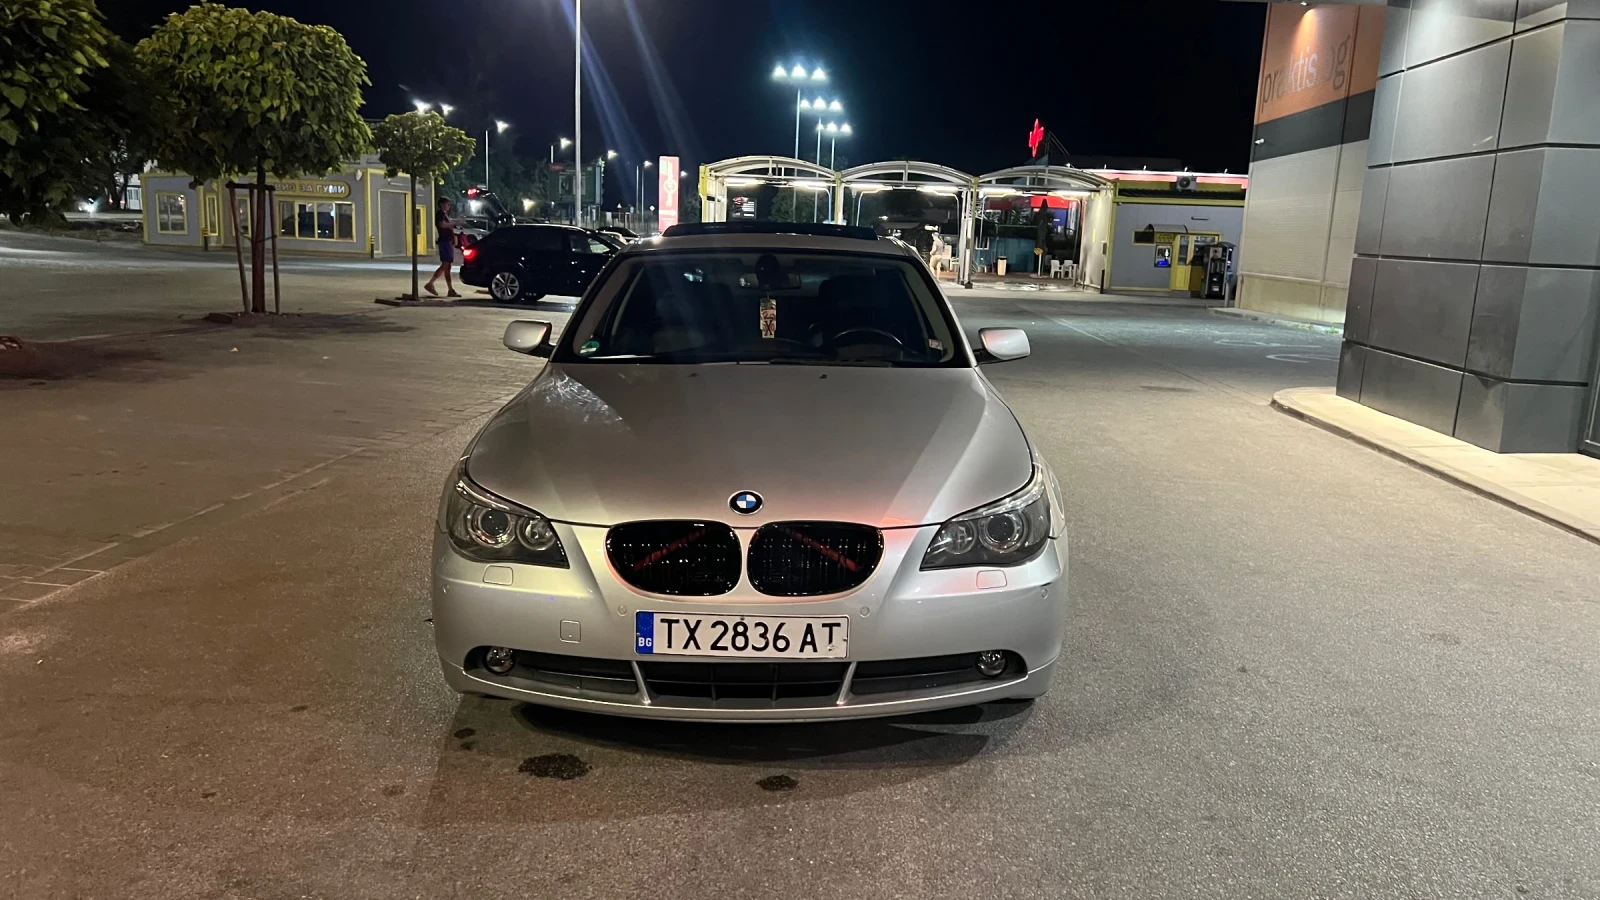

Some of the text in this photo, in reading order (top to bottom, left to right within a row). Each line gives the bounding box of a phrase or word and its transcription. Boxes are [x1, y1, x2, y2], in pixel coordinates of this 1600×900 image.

[638, 637, 652, 647] BG
[660, 618, 841, 653] TX 2836 AT
